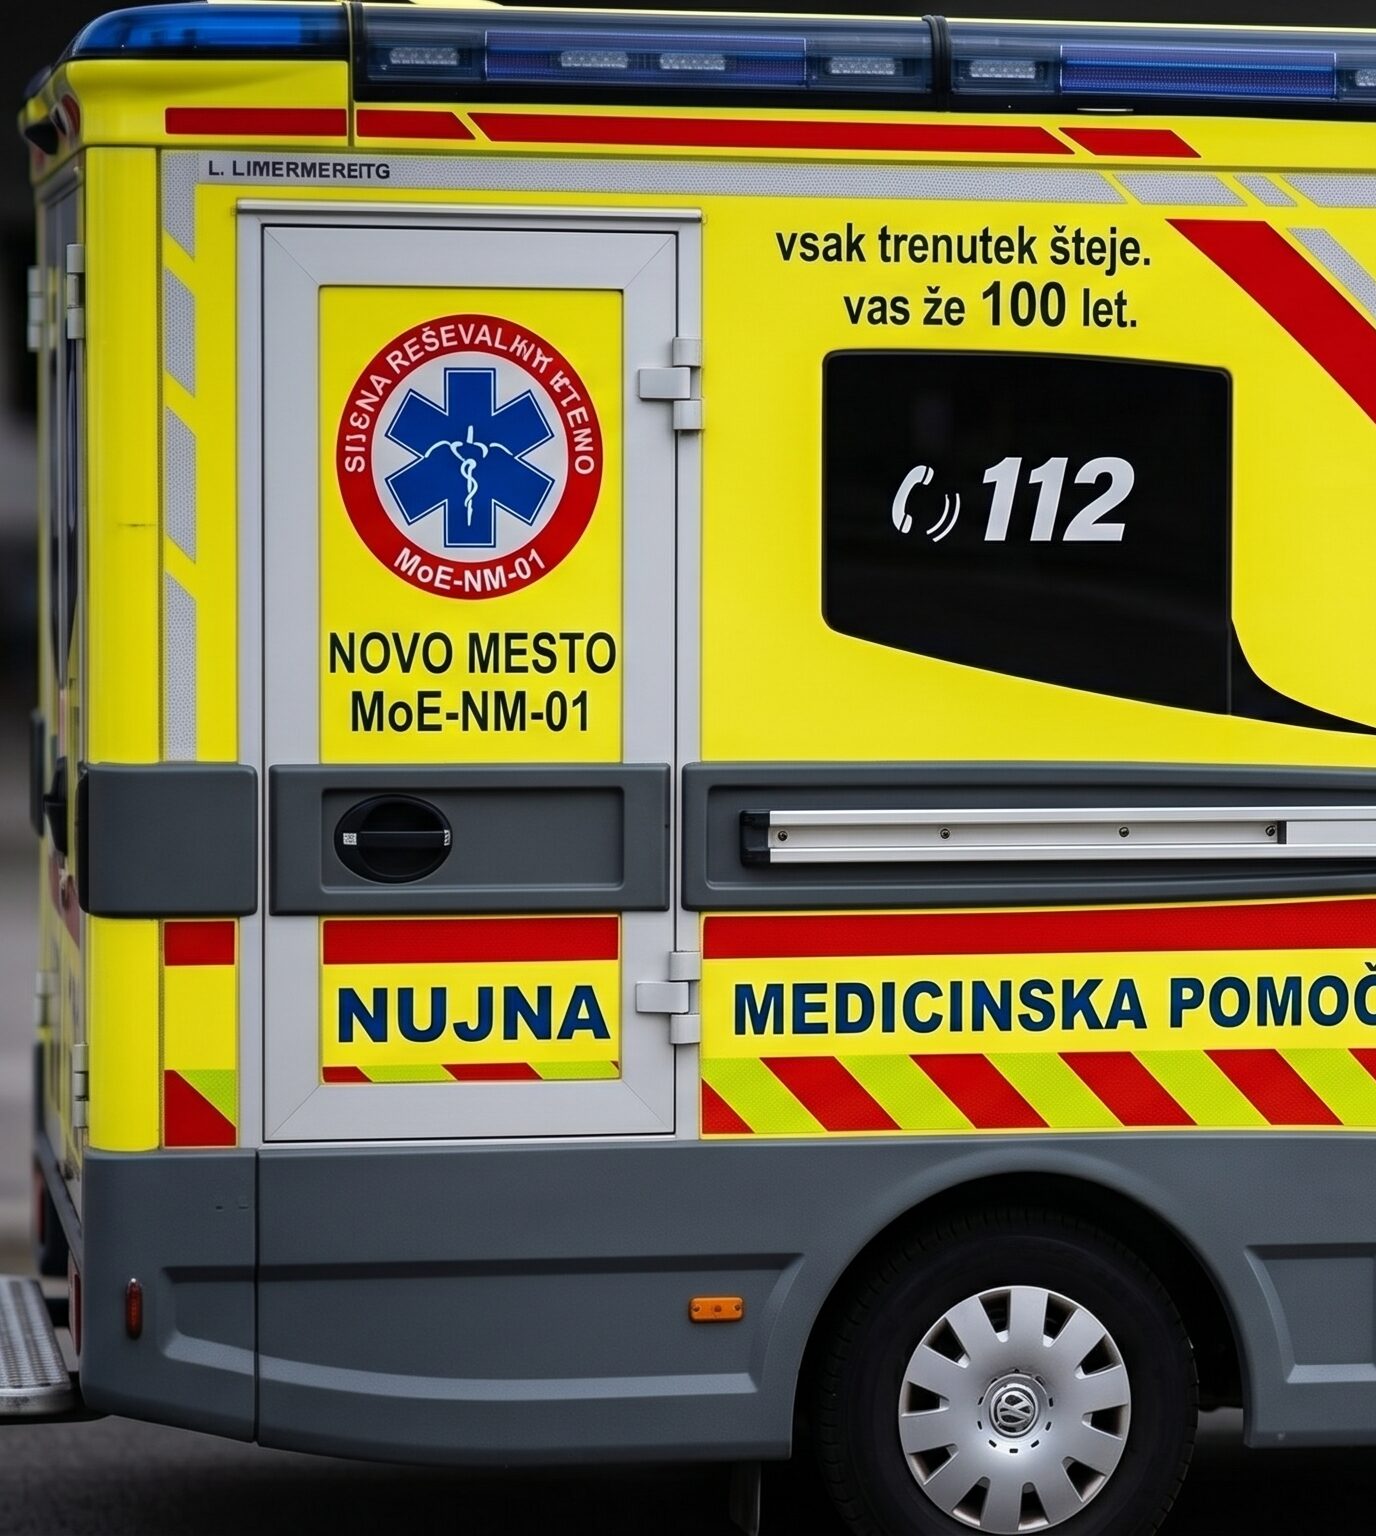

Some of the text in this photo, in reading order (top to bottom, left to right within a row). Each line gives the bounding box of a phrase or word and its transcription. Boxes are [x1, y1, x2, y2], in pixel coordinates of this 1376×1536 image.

[208, 160, 224, 176] L.
[775, 222, 1151, 277] vsak trenutek šteje.
[843, 280, 1138, 328] vas že 100 let.
[982, 456, 1135, 542] 112
[393, 547, 546, 593] MoE-NM-01
[329, 631, 616, 674] NOVO MESTO
[351, 690, 588, 733] MoE-NM-01
[338, 985, 612, 1043] NUJNA
[734, 978, 1148, 1036] MEDICINSKA
